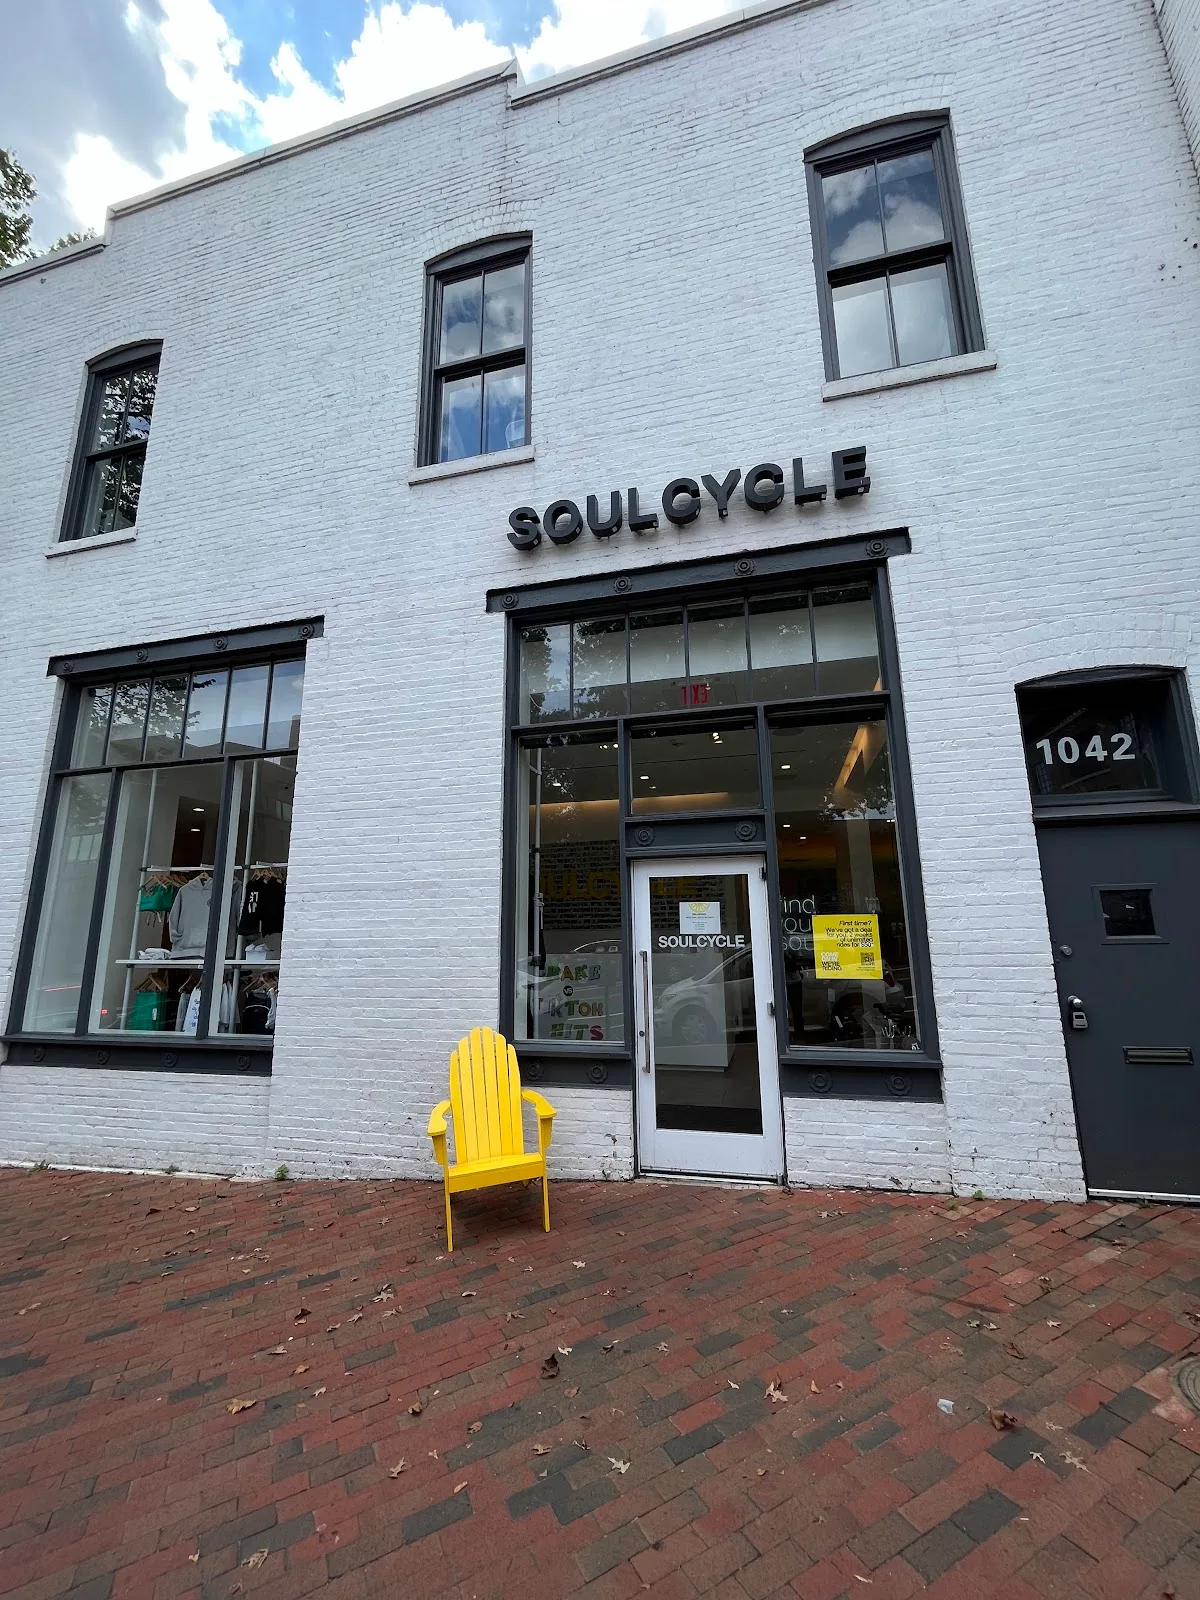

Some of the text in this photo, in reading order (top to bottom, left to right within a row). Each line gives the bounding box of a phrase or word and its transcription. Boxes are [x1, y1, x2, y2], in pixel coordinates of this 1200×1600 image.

[507, 445, 871, 551] SOULCYCLE
[1036, 732, 1136, 765] 1042
[780, 894, 816, 914] ind
[658, 934, 745, 948] SOULCYCLE
[550, 1023, 604, 1041] HITS
